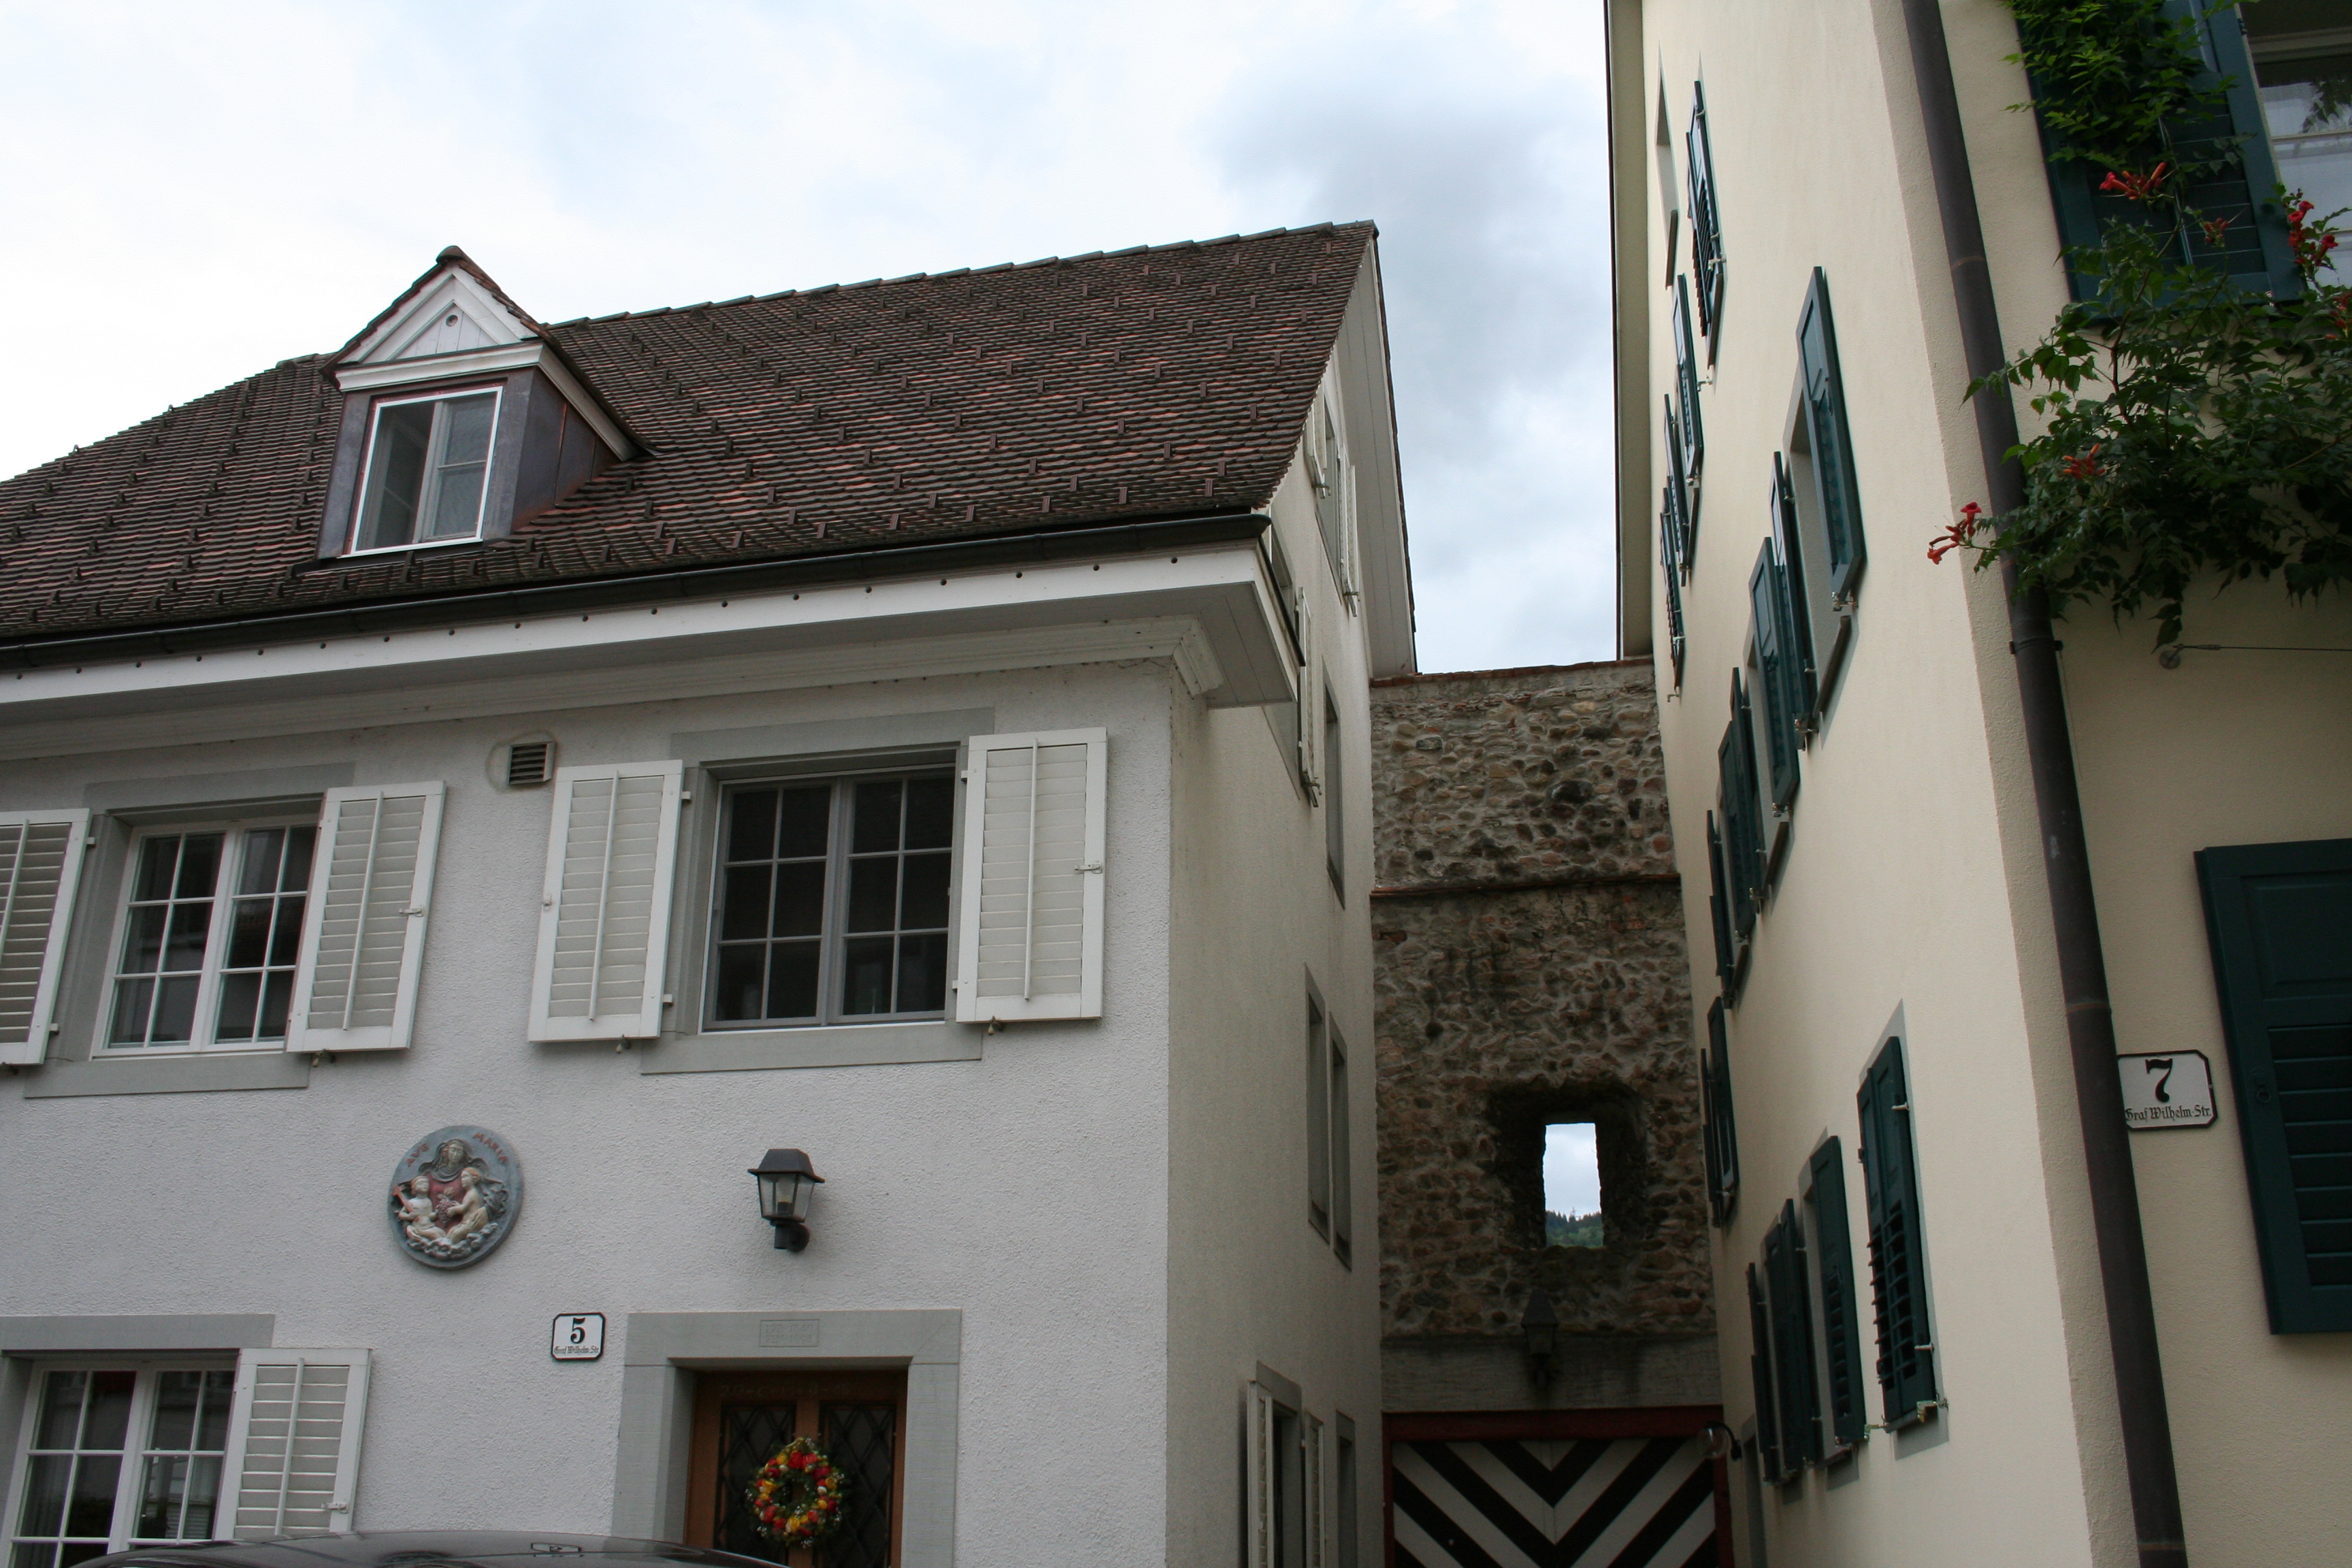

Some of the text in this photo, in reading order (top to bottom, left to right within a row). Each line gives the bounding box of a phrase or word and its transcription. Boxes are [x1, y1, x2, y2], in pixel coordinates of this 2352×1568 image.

[2145, 1058, 2173, 1102] 7
[2125, 1107, 2147, 1122] Graf
[406, 1132, 508, 1167] AVE MARIA
[570, 1317, 585, 1344] 5
